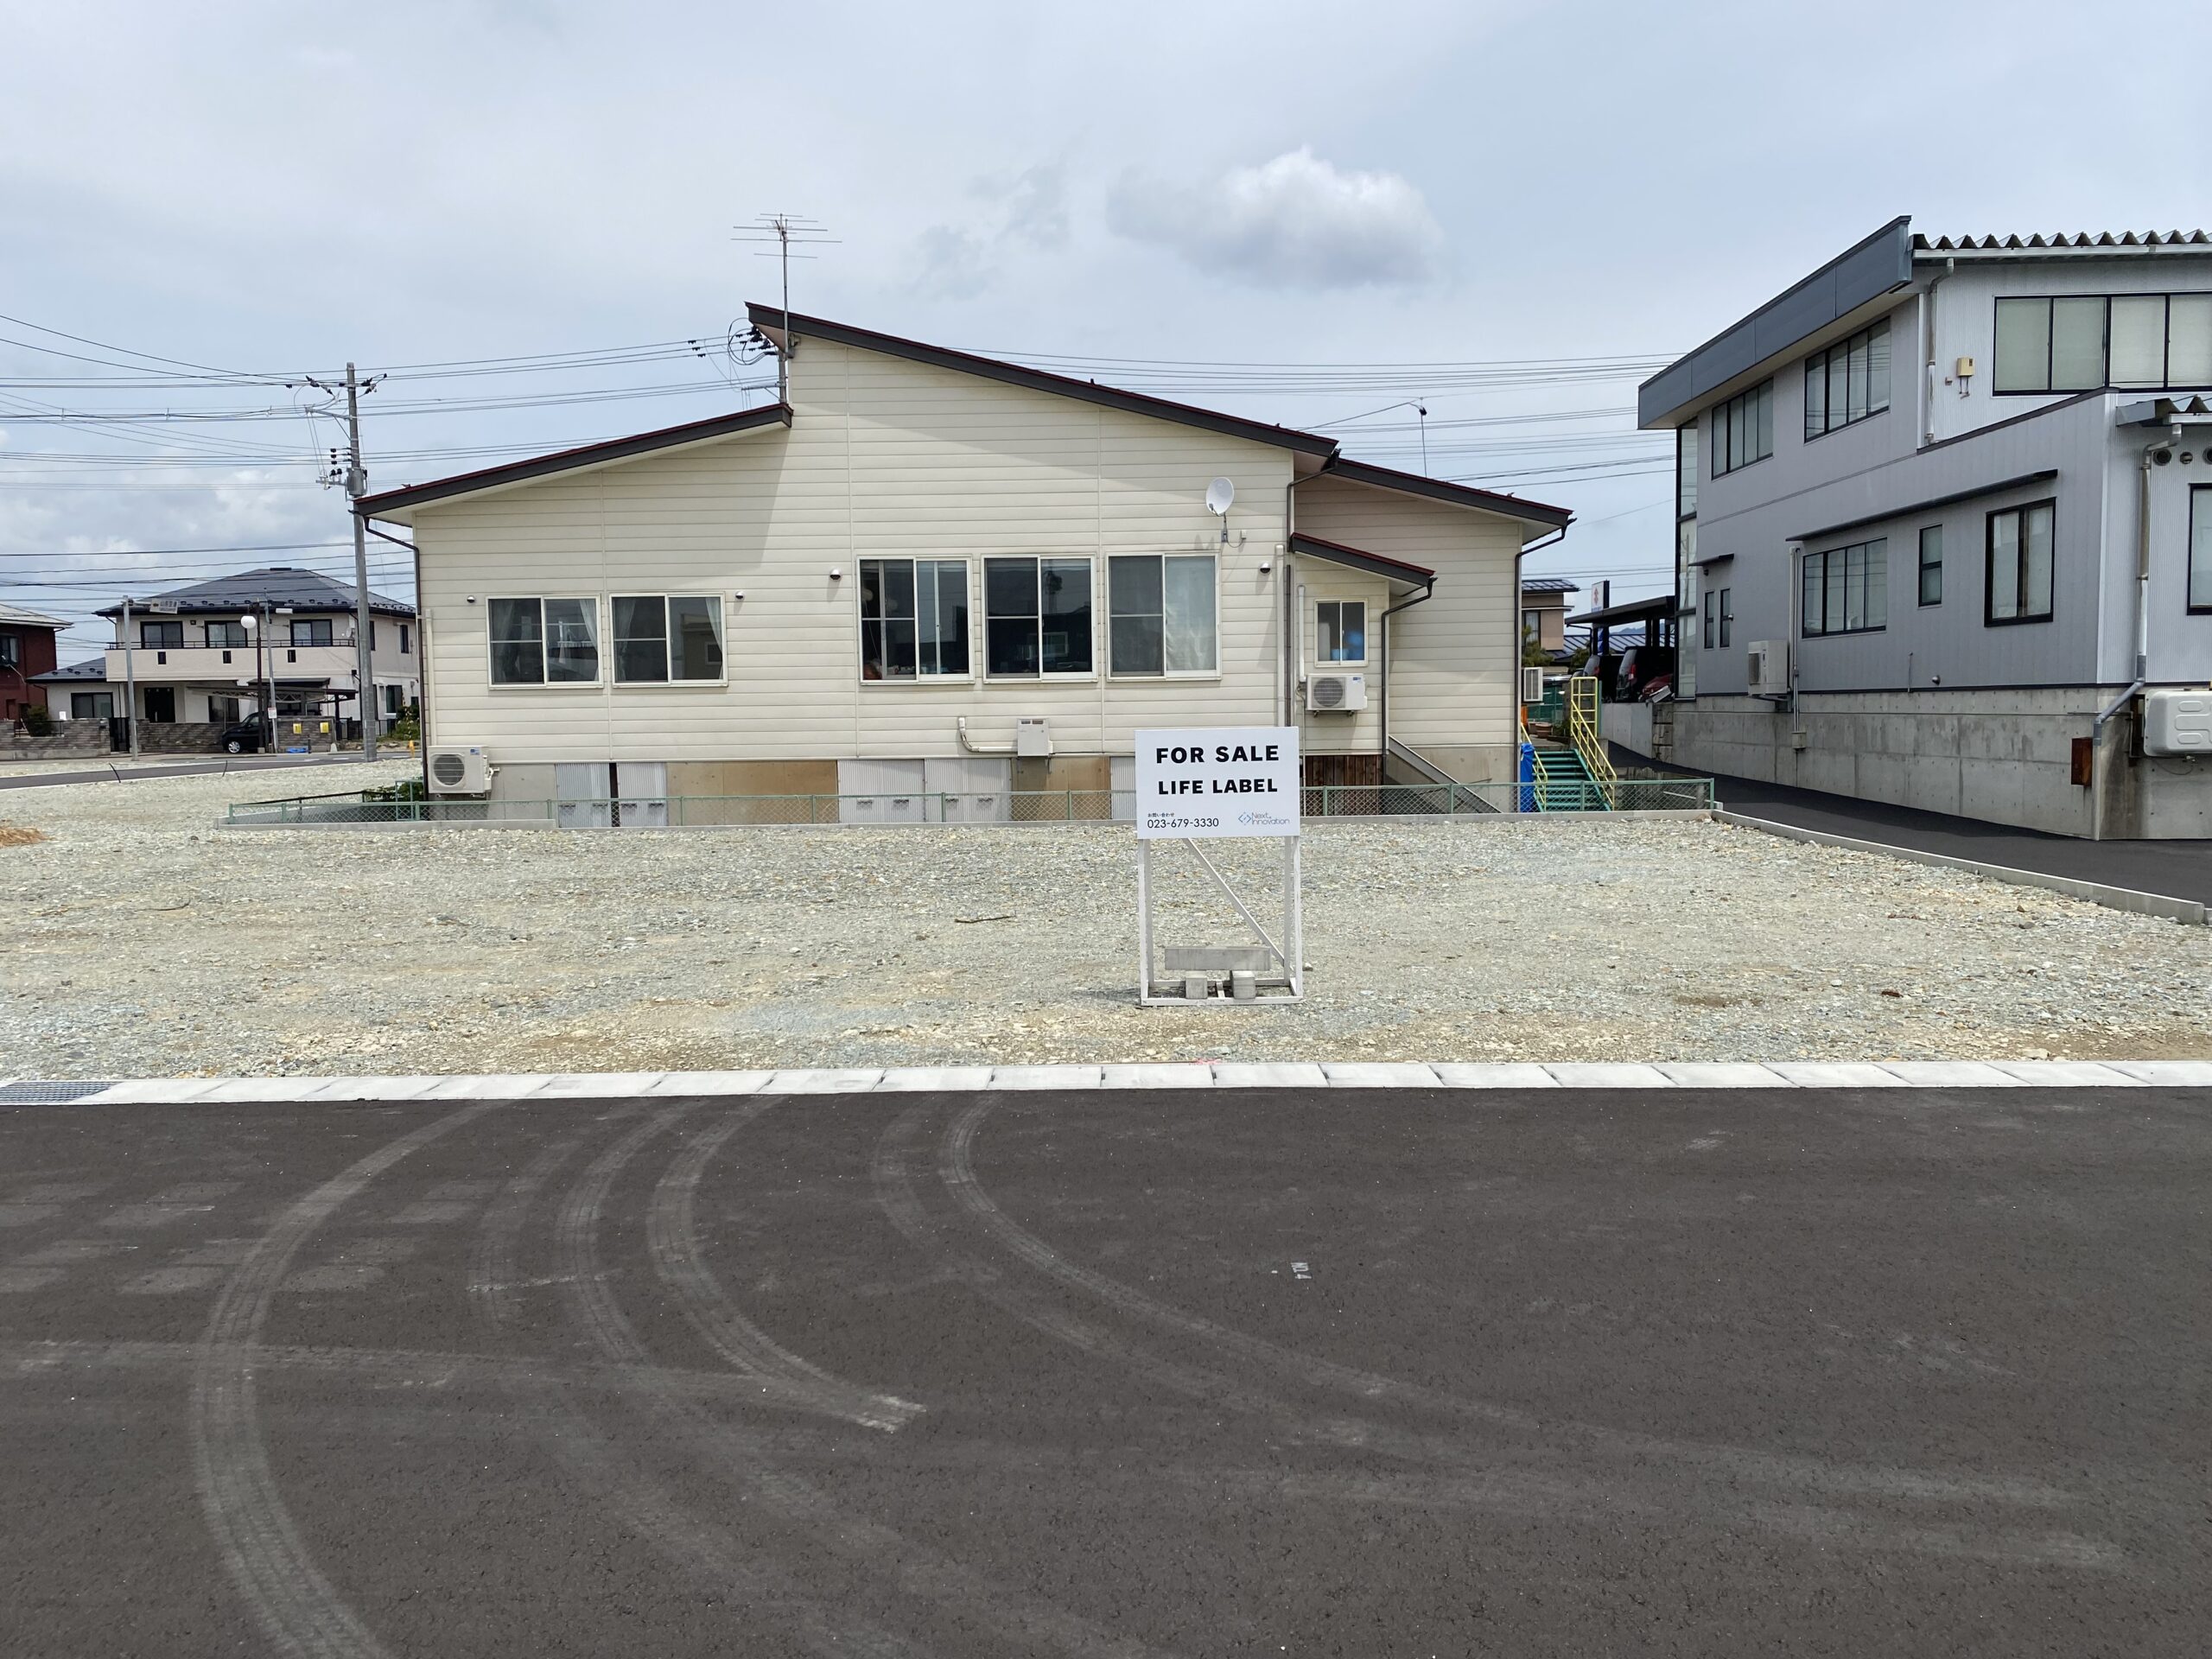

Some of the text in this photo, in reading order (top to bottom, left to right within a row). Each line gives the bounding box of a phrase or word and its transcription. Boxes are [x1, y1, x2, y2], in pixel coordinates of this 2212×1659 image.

[1156, 745, 1279, 764] FOR SALE
[1159, 779, 1278, 795] LIFE LABEL
[1147, 817, 1219, 829] 023-679-3330
